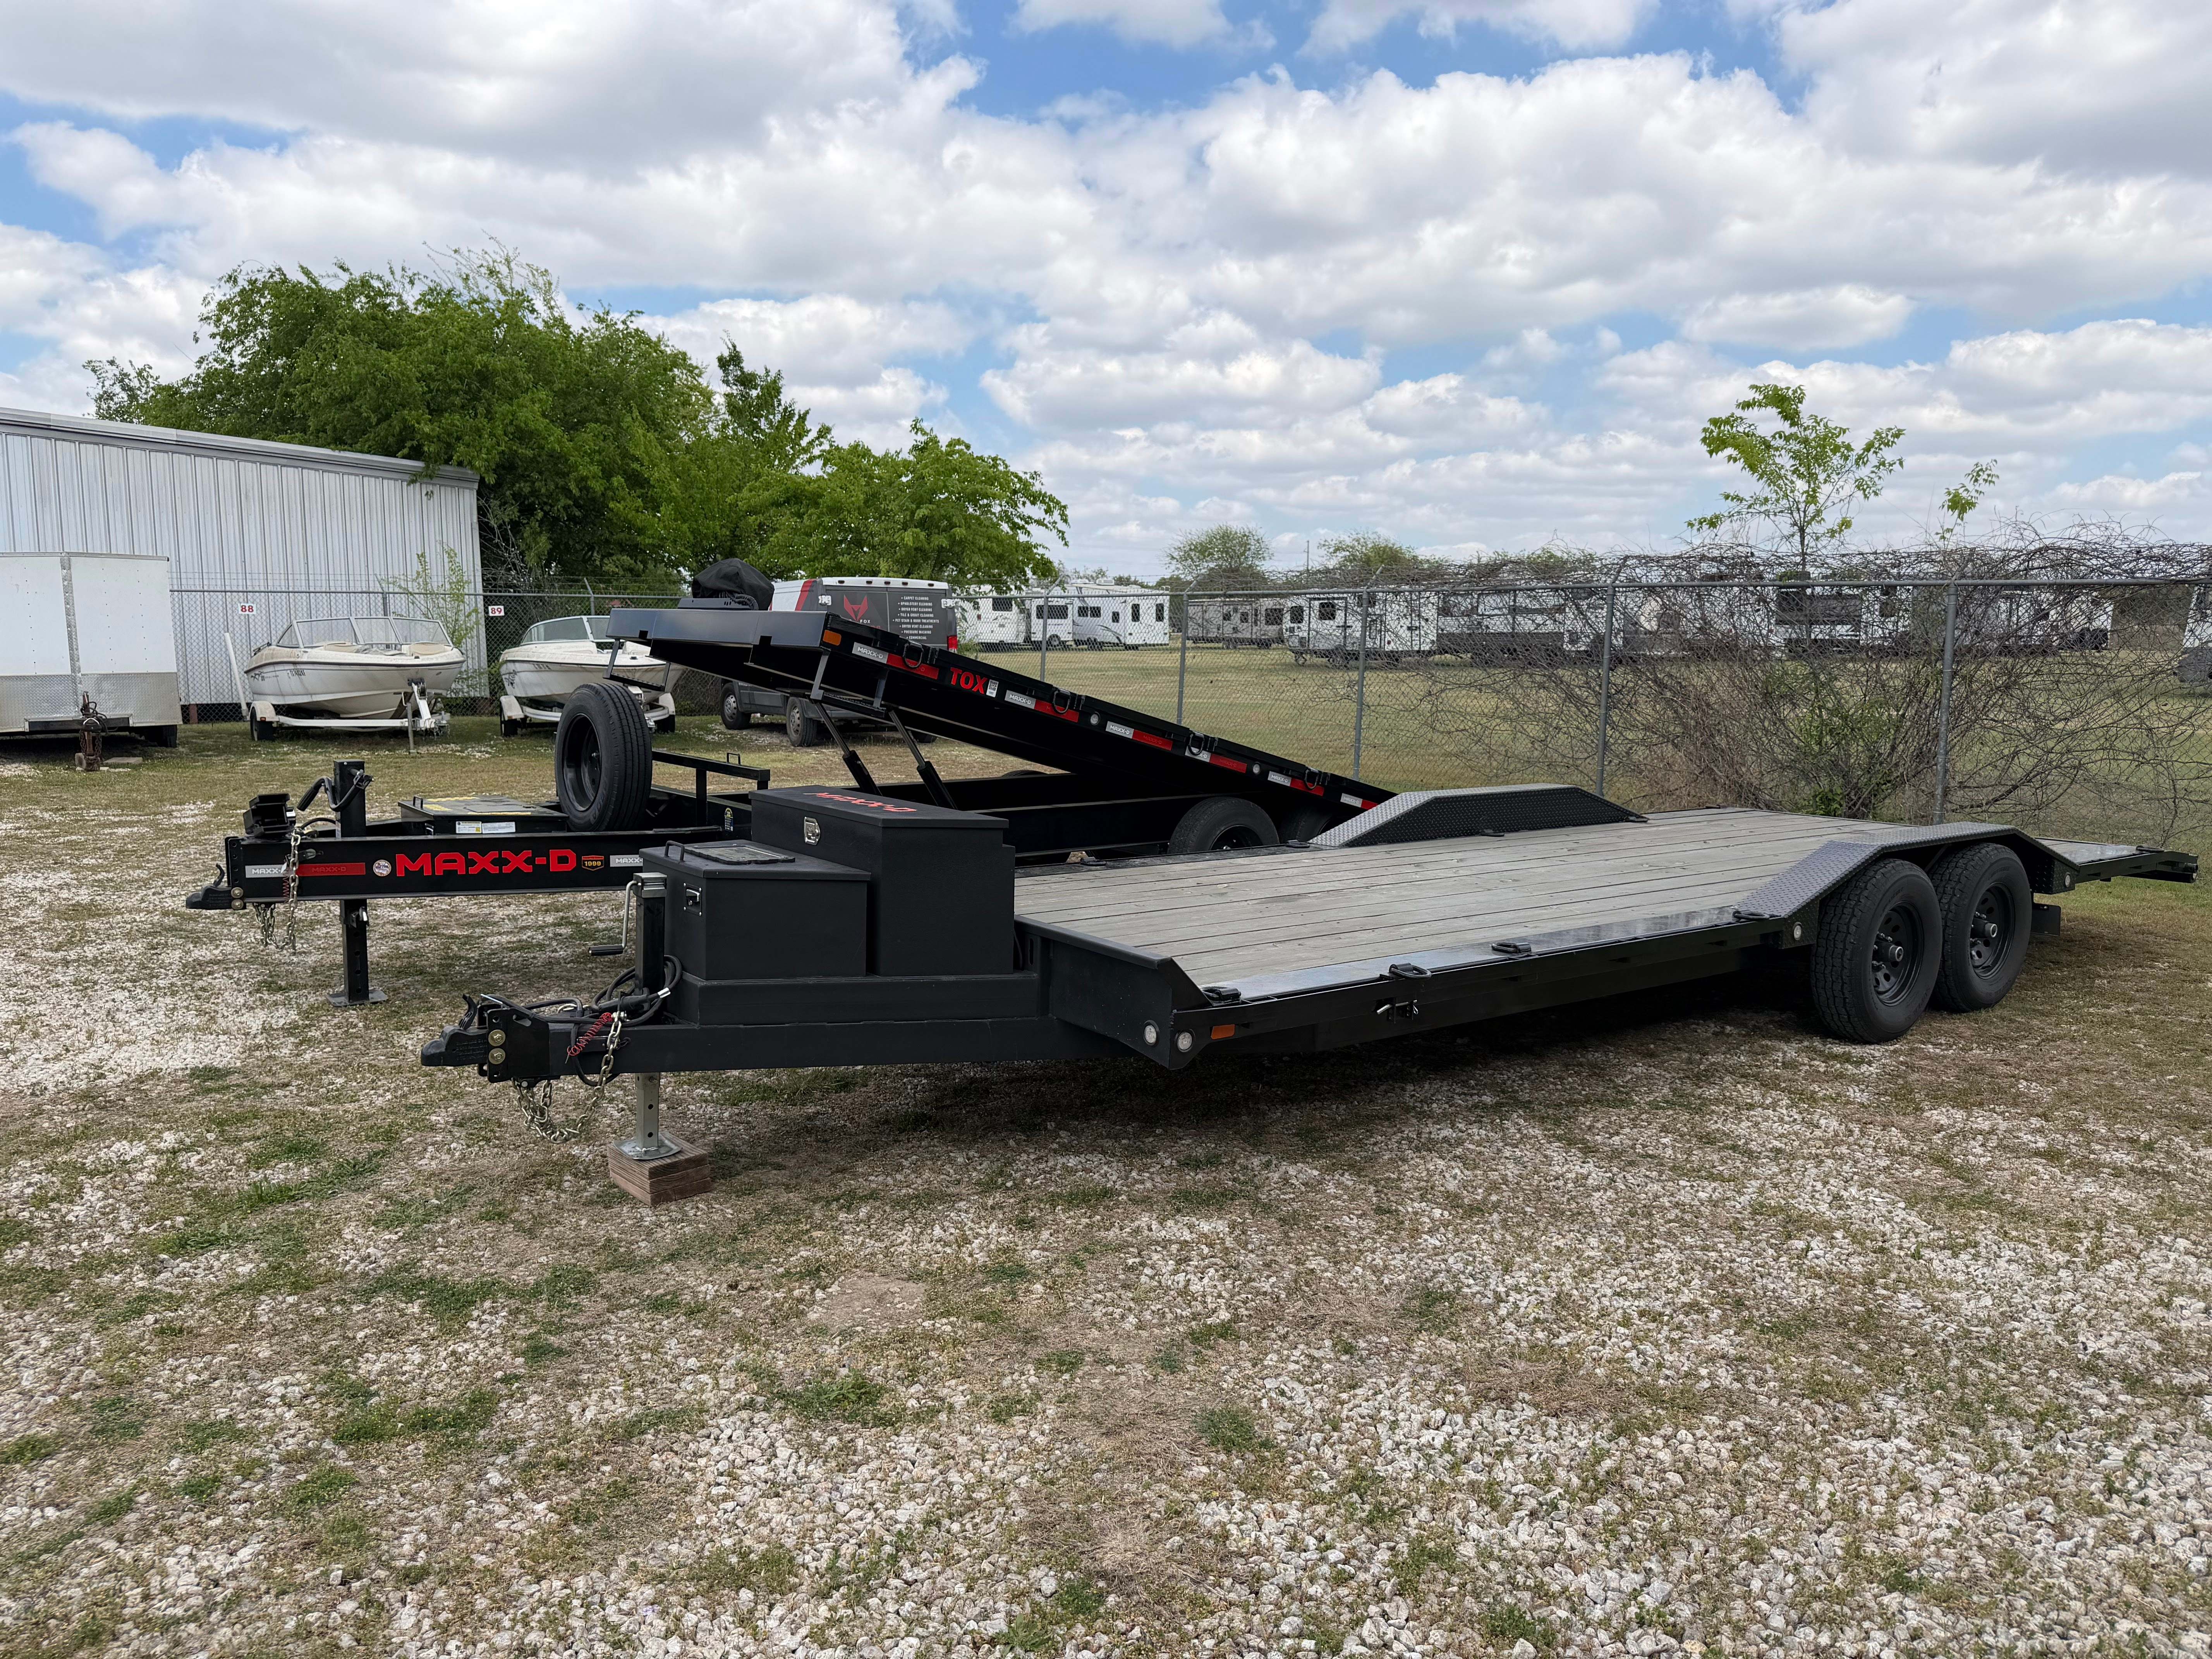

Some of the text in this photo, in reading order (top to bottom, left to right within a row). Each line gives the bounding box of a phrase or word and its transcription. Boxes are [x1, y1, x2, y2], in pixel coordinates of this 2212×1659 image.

[950, 667, 988, 694] TOX
[803, 792, 917, 812] MAXX-D
[396, 849, 576, 876] MAXX-D
